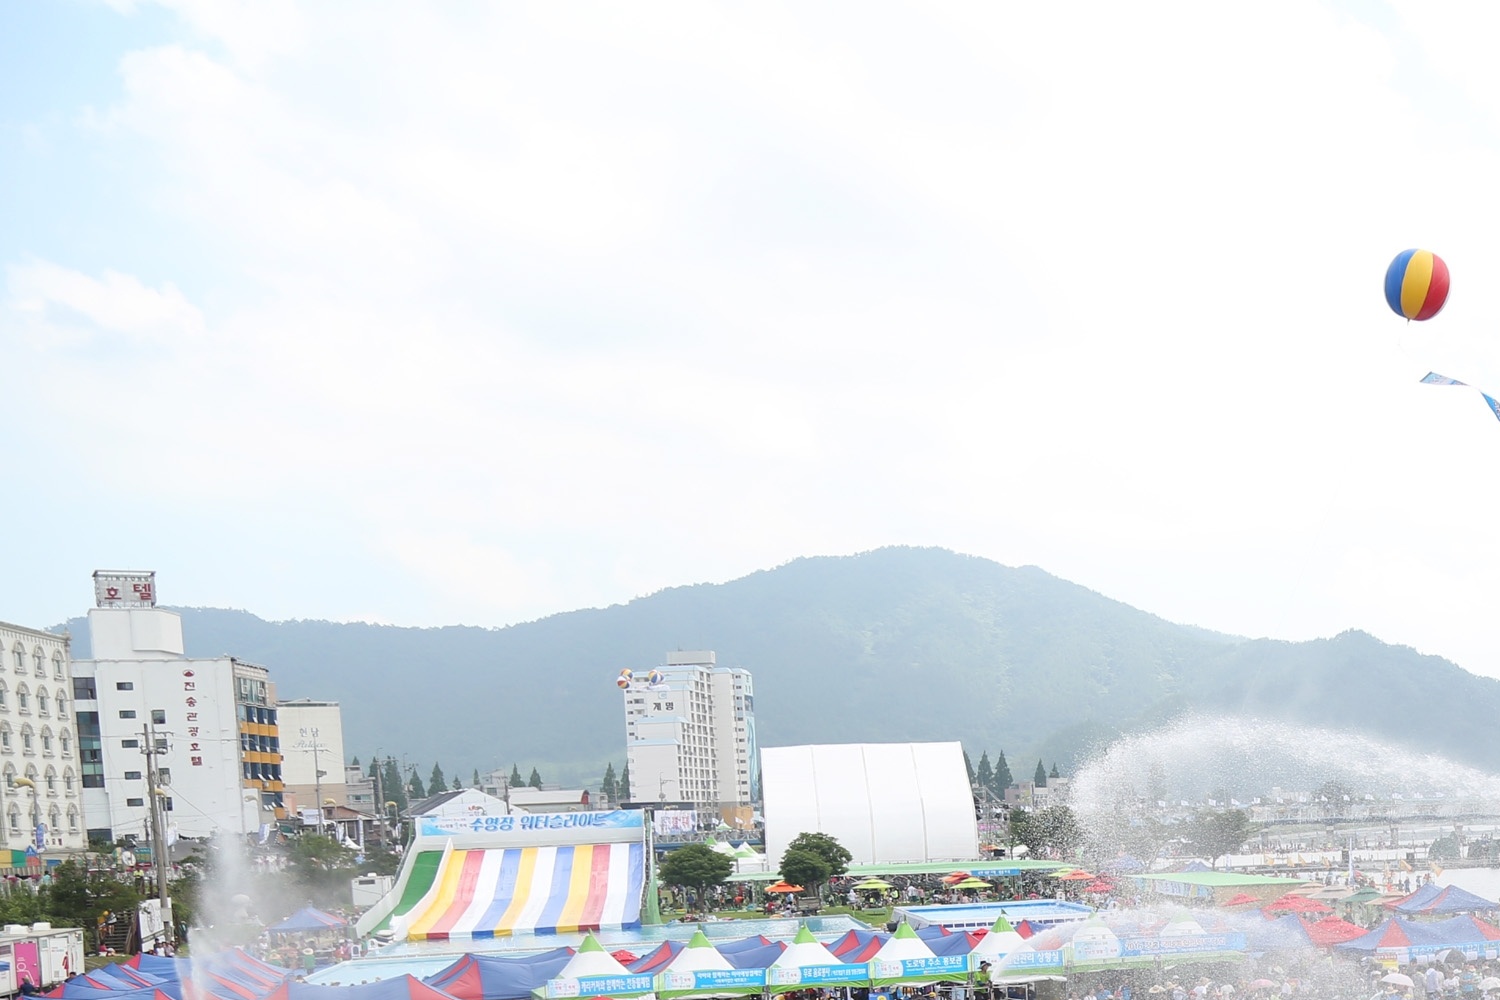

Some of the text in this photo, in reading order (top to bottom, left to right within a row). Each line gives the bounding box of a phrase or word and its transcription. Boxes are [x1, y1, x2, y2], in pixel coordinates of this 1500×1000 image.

[104, 583, 152, 600] 호텔
[652, 702, 674, 711] 계명
[184, 681, 203, 766] 진송관광호텔
[469, 815, 515, 832] 수영장
[520, 812, 607, 830] 워터슬라이드
[906, 959, 925, 968] 도로명
[927, 958, 942, 967] 주소
